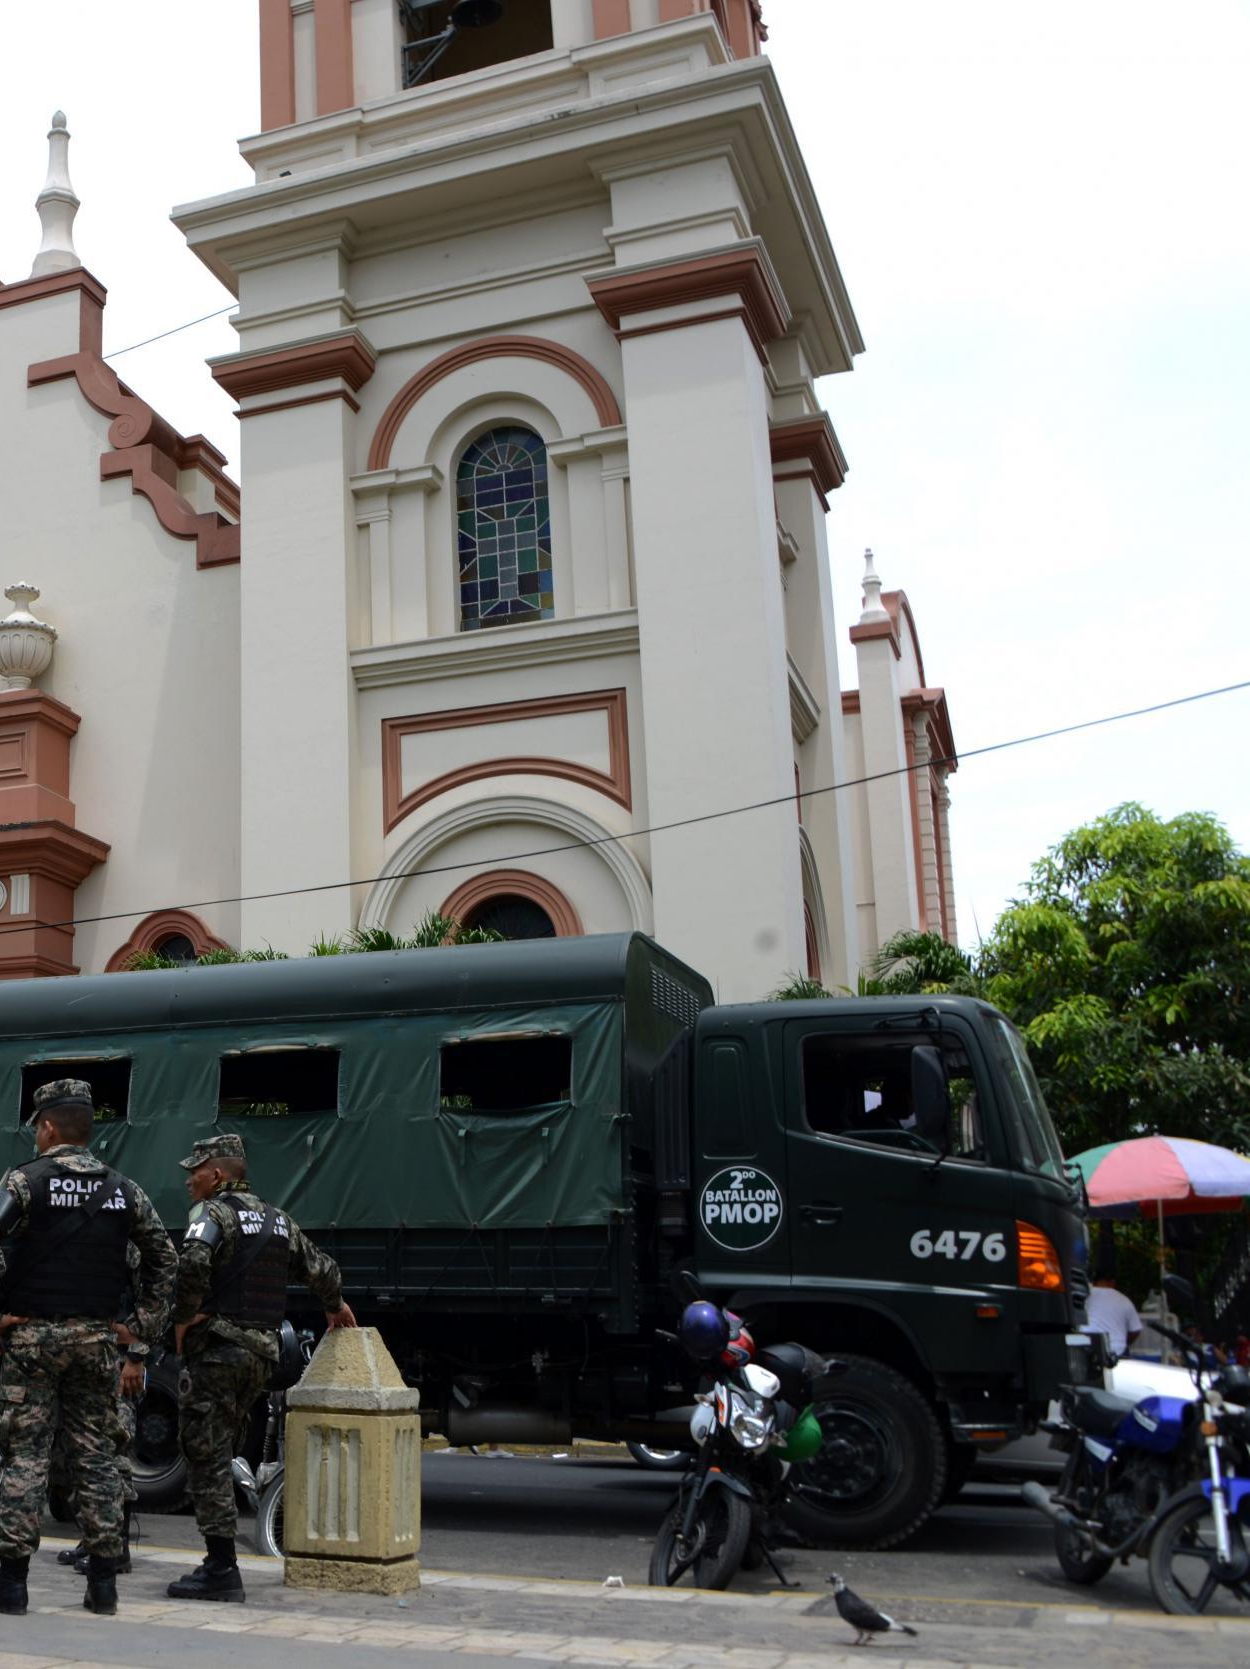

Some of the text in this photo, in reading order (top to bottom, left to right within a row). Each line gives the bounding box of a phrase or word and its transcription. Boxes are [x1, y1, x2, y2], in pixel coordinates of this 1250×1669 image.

[50, 1193, 127, 1209] MILAR
[705, 1189, 777, 1202] BATALLON
[705, 1203, 779, 1224] PMOP
[910, 1229, 1006, 1262] 6476
